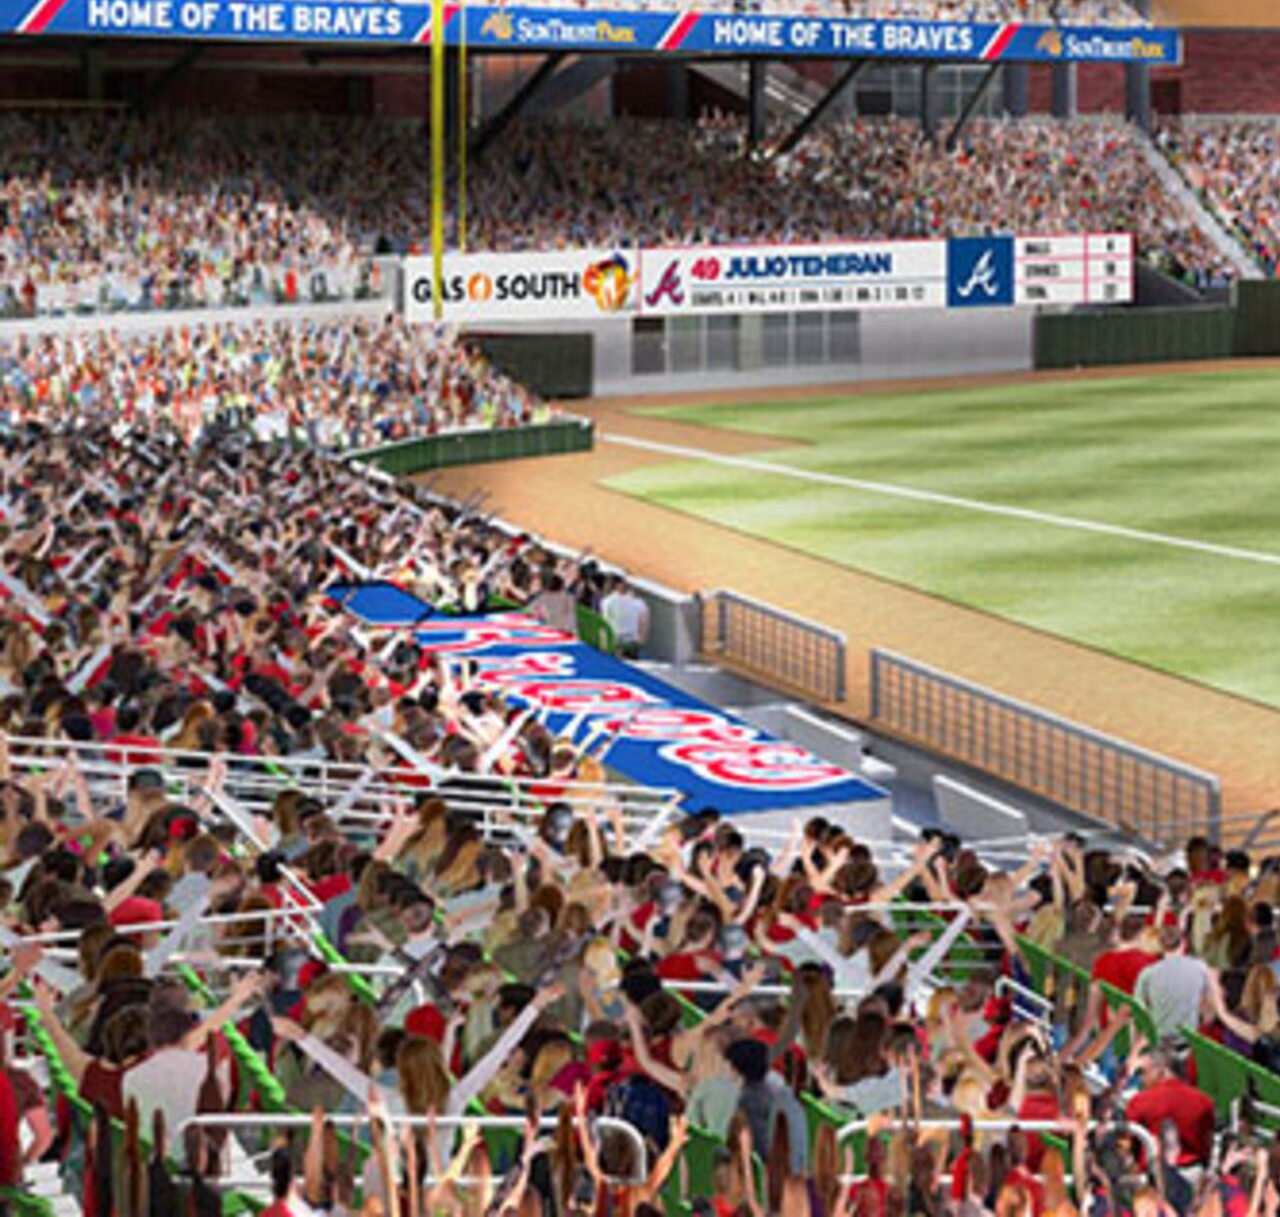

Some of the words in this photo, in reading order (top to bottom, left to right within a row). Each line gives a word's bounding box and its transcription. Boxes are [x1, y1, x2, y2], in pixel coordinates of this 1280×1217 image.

[88, 0, 173, 30] HOME
[180, 1, 220, 31] OF
[229, 2, 284, 32] THE
[292, 4, 403, 36] BRAVES
[713, 19, 785, 47] HOME
[792, 20, 822, 48] OF
[829, 21, 875, 49] THE
[881, 23, 973, 52] BRAVES
[495, 272, 580, 301] SOUTH
